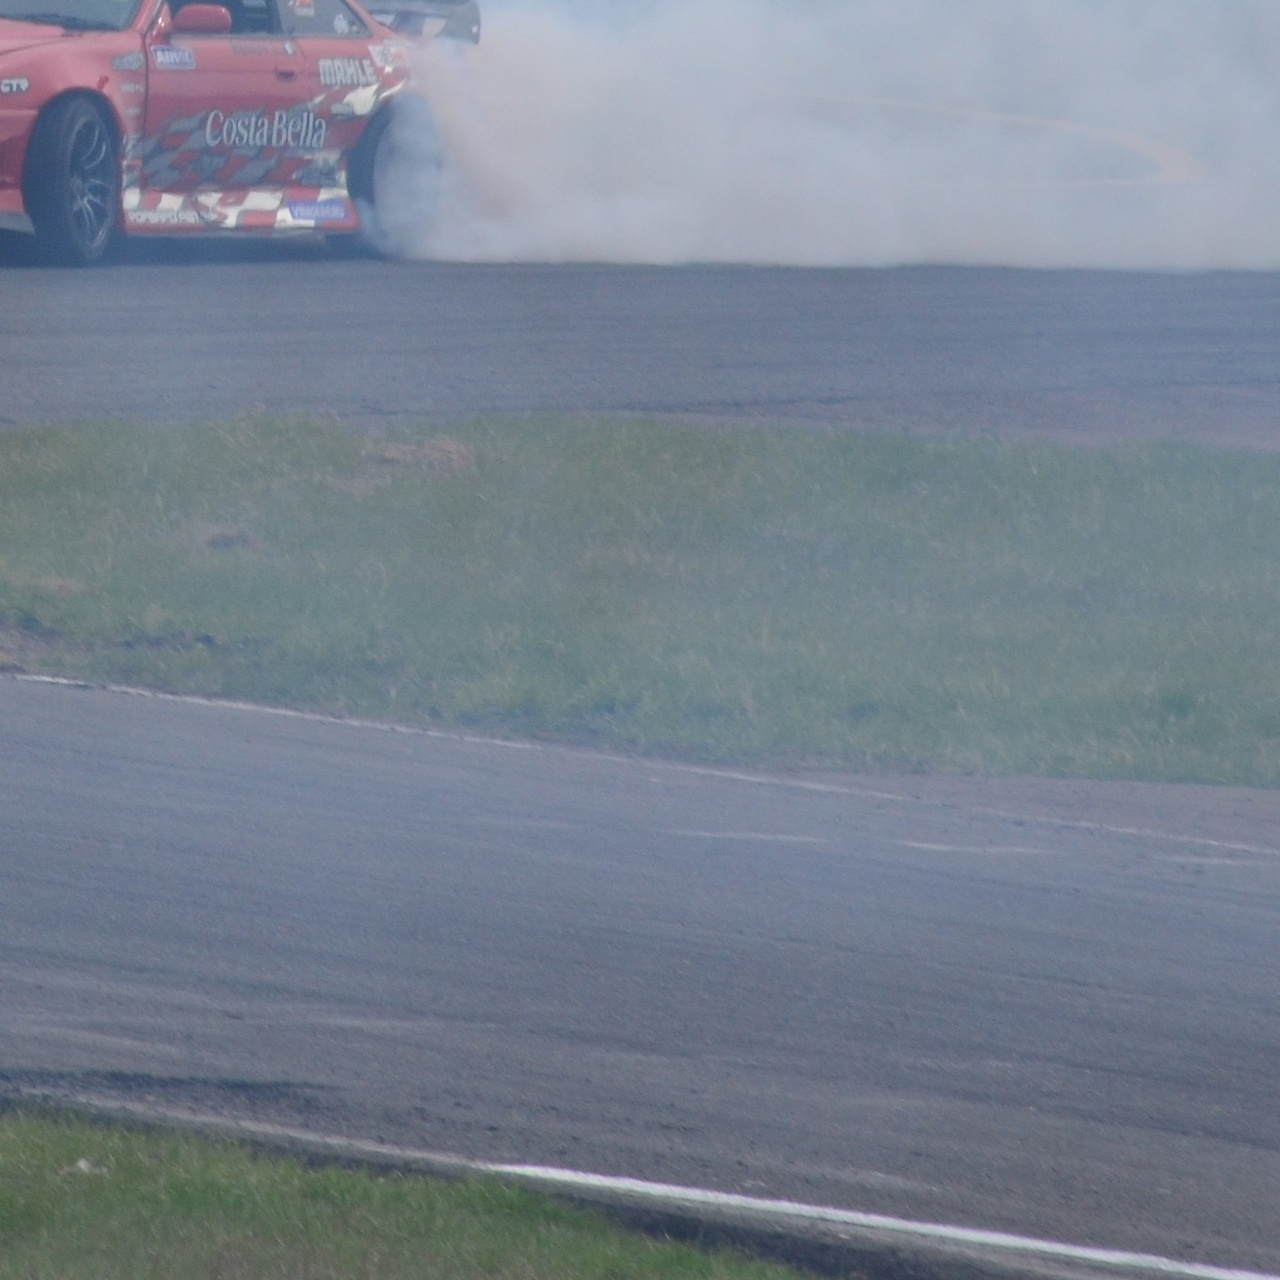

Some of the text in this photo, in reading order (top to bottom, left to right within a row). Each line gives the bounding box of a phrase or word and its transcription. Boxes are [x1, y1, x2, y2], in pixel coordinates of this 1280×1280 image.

[318, 57, 377, 86] MAHLE
[205, 110, 327, 148] Costa Bella
